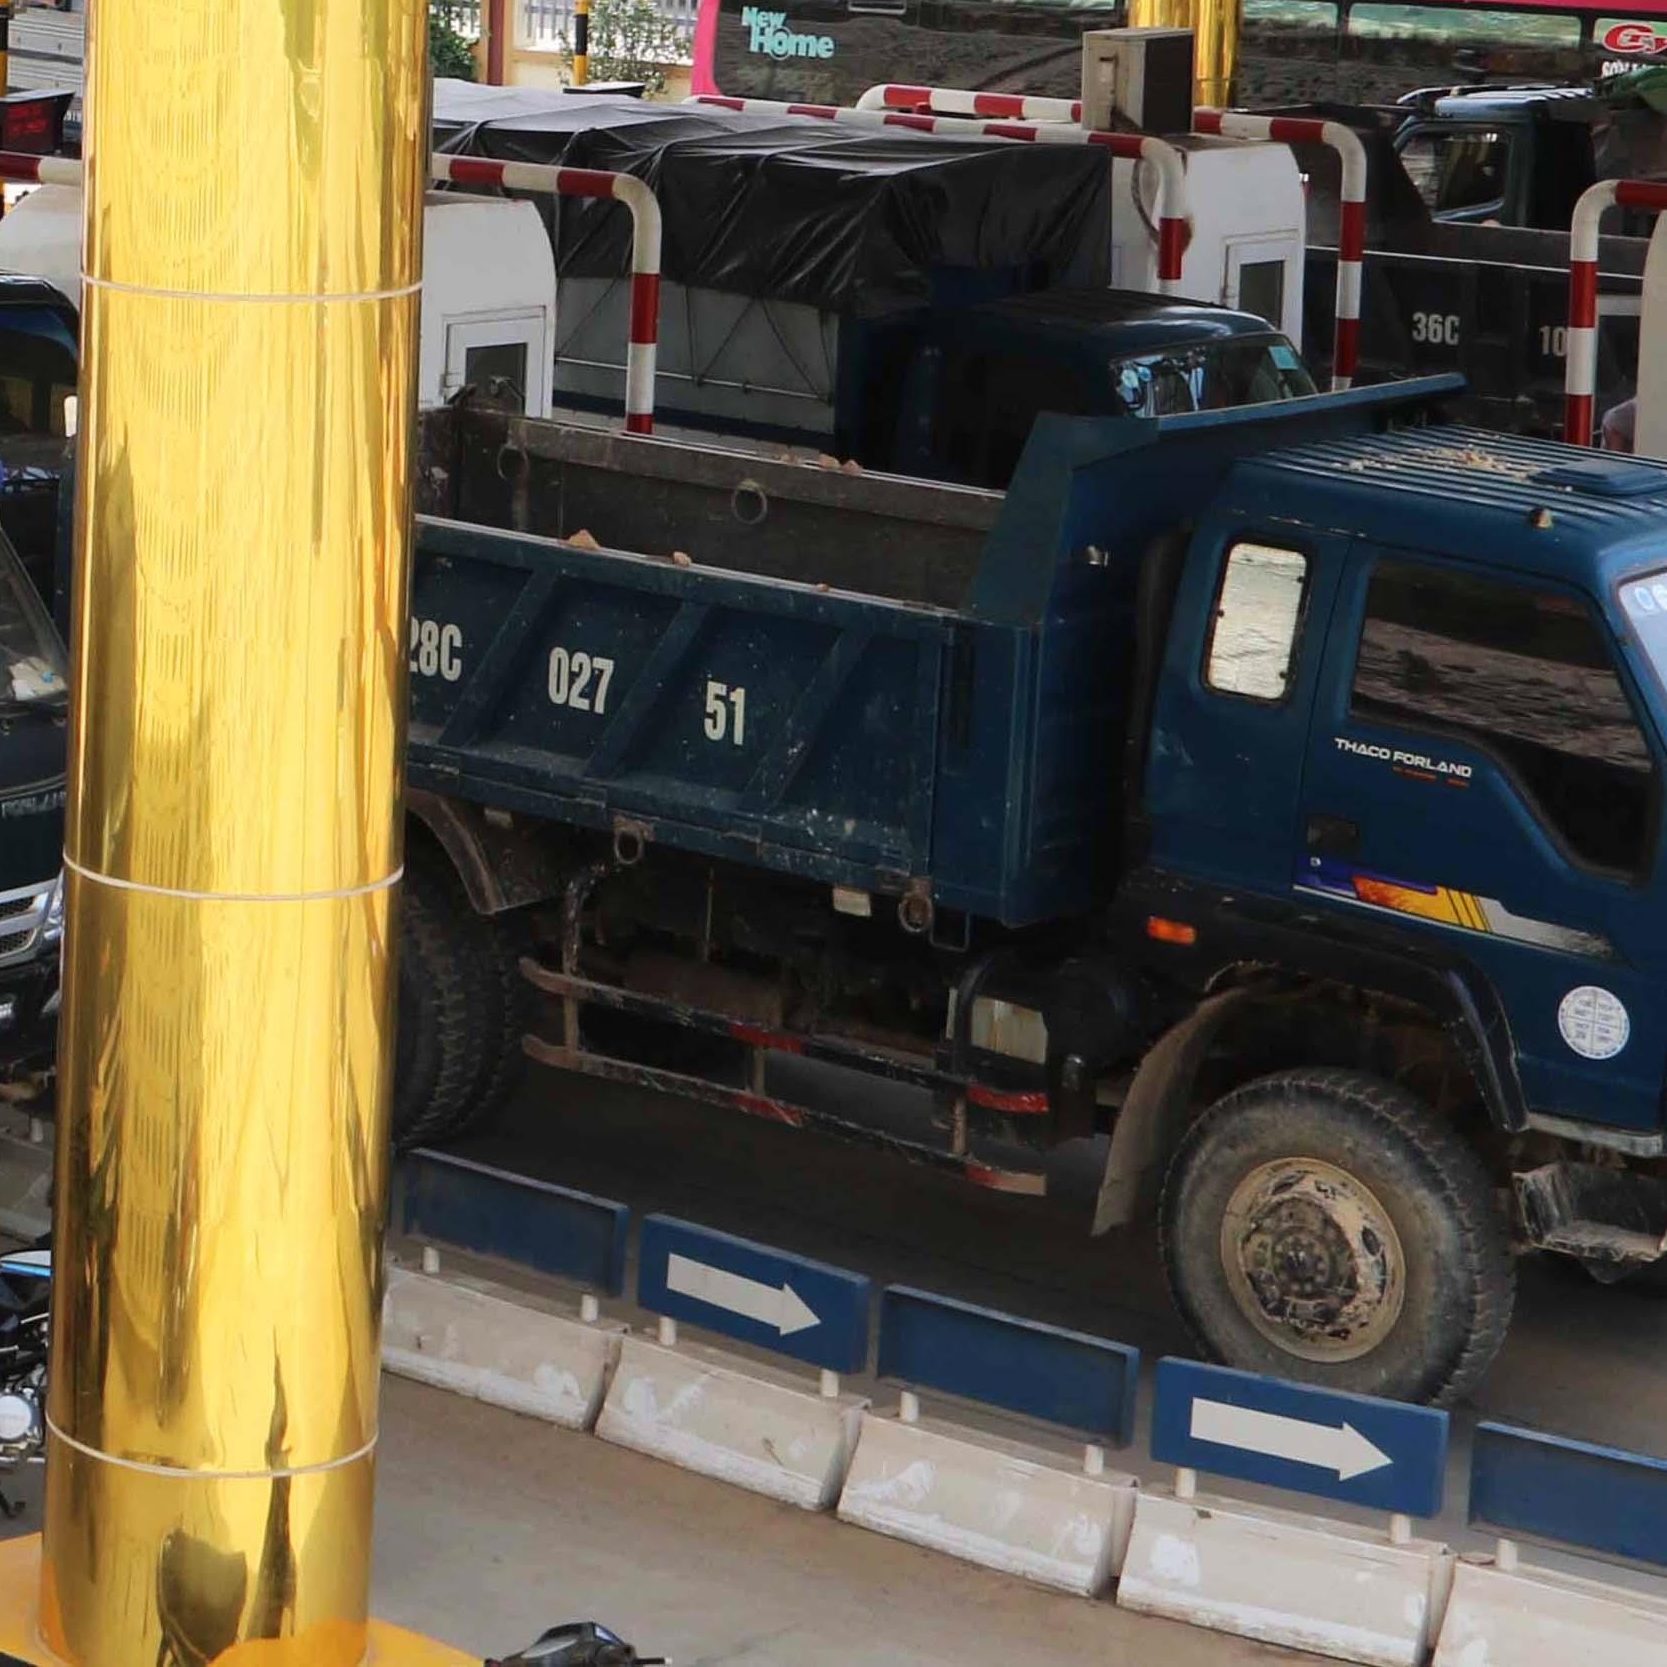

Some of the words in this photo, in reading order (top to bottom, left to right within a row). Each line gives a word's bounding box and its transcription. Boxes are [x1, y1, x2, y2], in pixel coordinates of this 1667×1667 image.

[742, 6, 787, 27] New
[750, 25, 834, 61] Home
[1412, 311, 1460, 346] 36C
[548, 647, 615, 715] 027
[704, 681, 746, 746] 51
[1333, 737, 1390, 760] THACO
[1393, 751, 1472, 778] FORLAND
